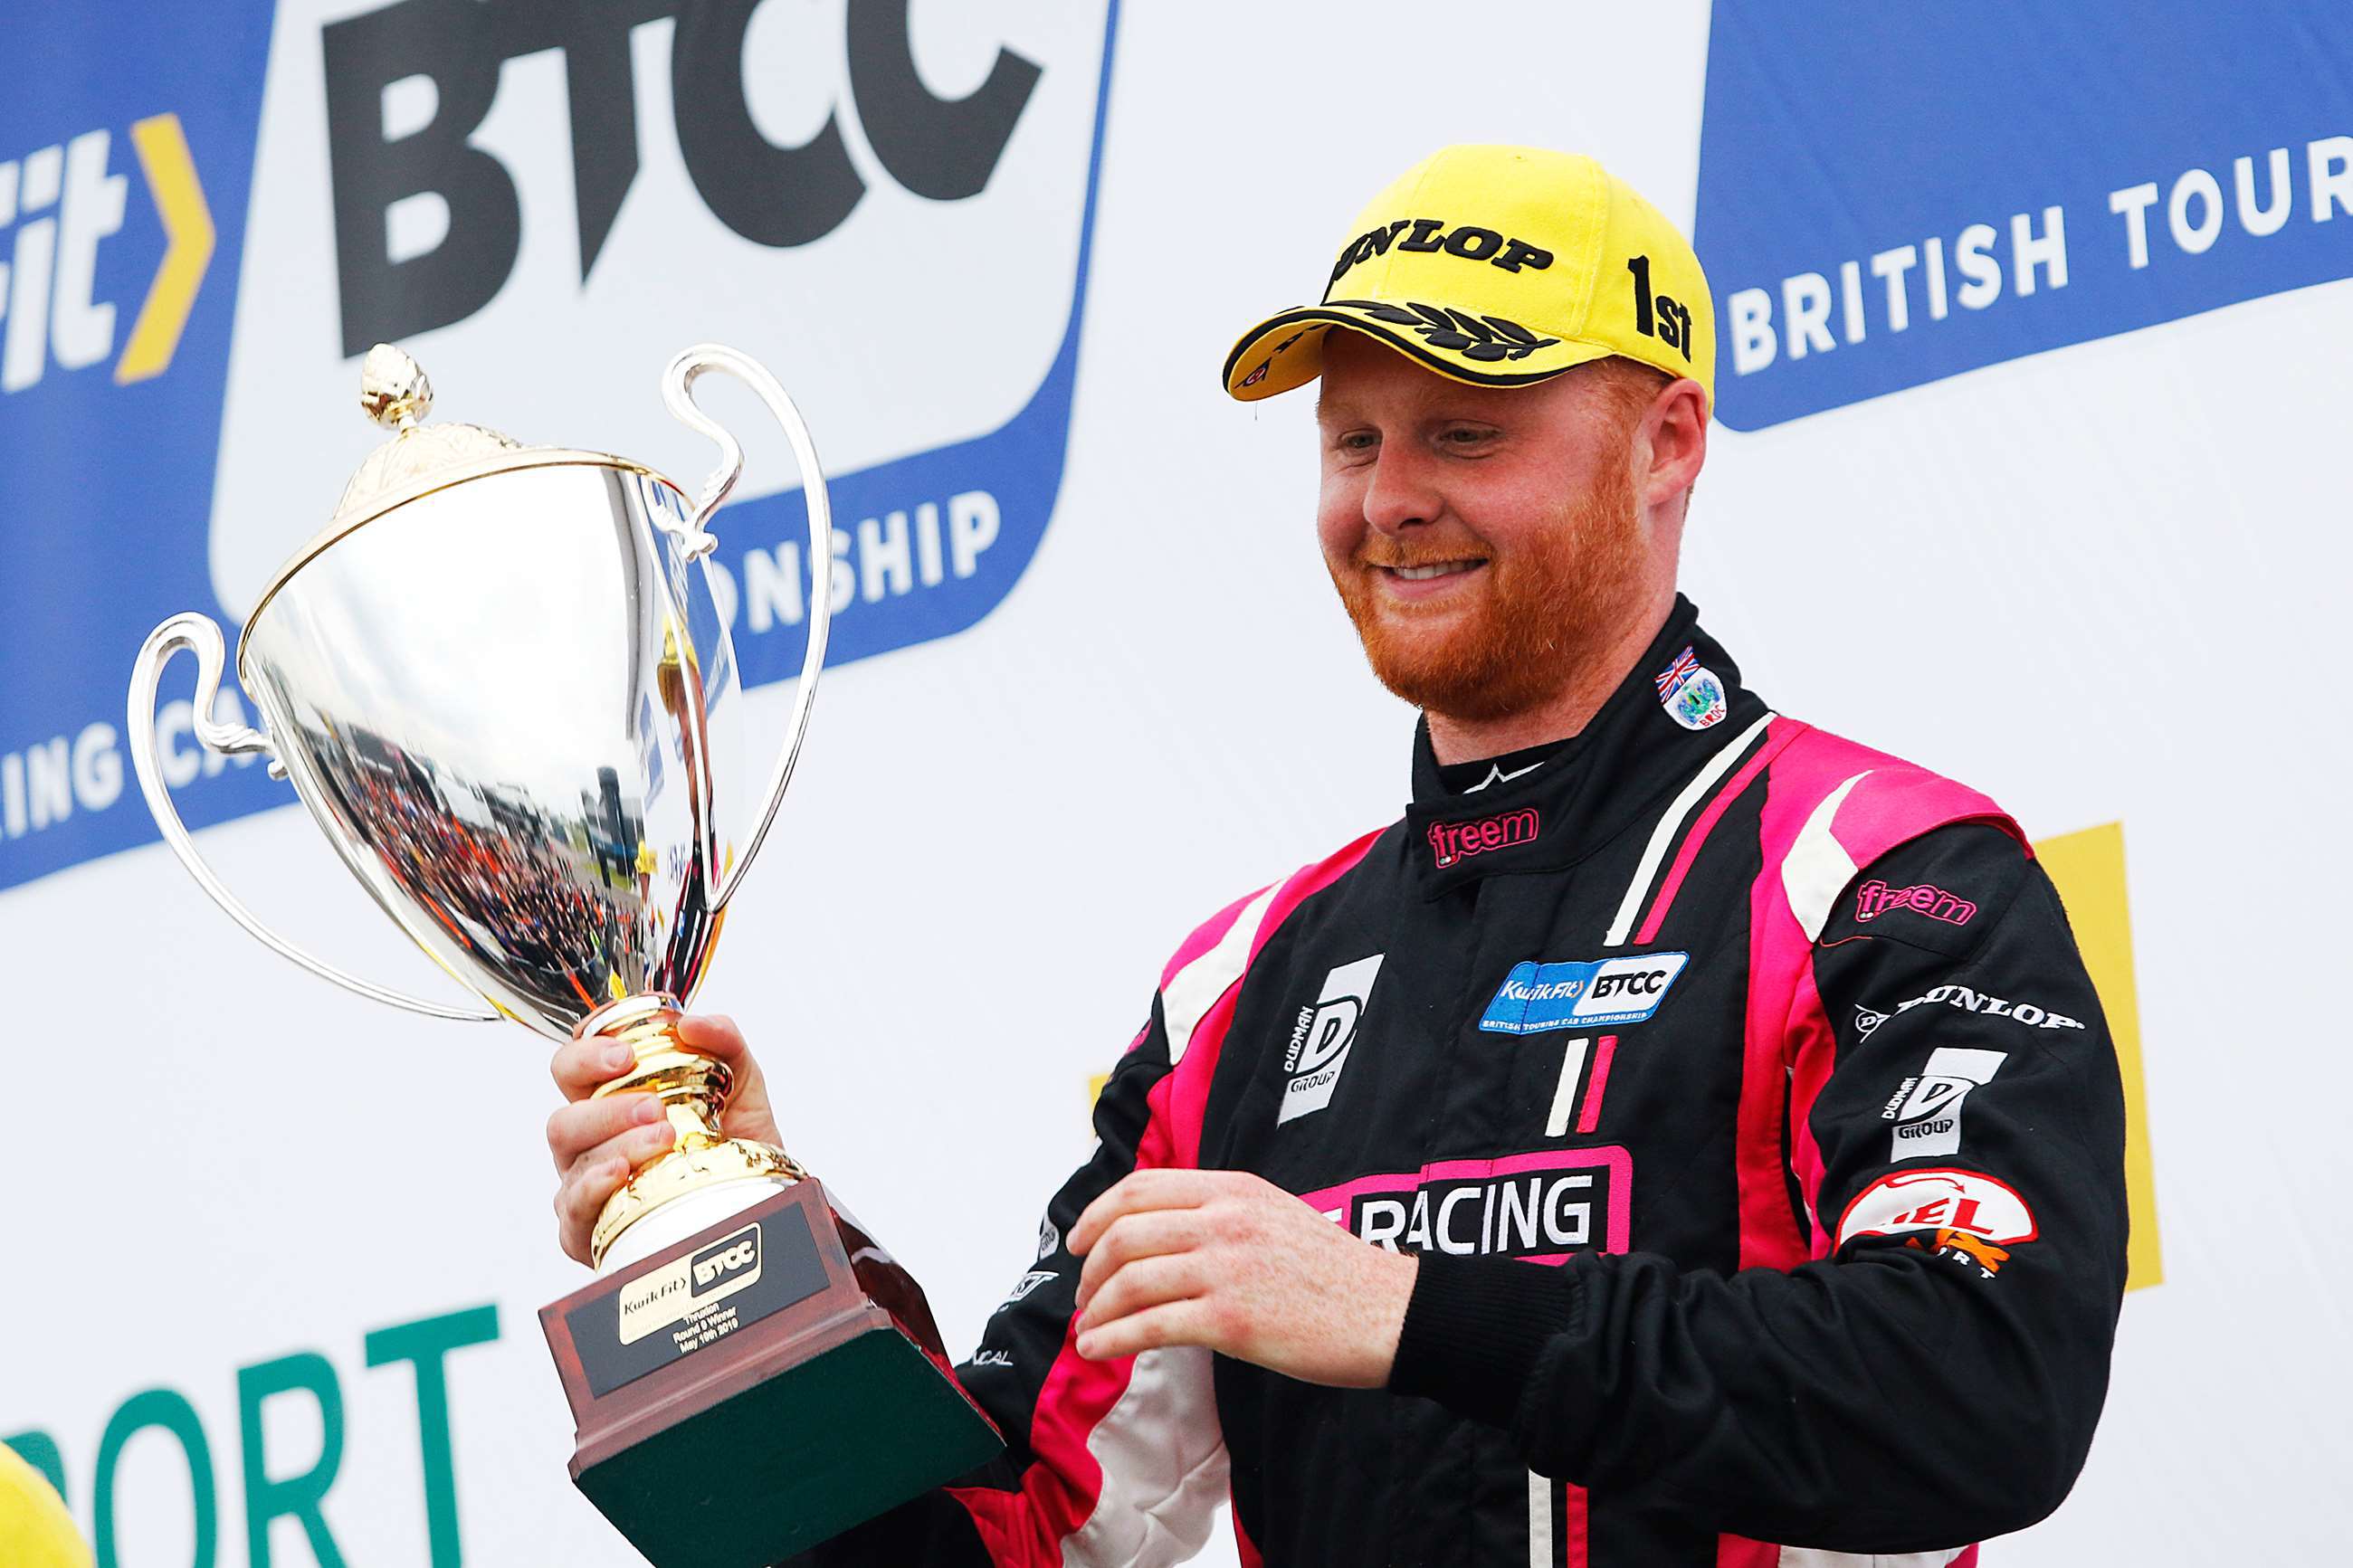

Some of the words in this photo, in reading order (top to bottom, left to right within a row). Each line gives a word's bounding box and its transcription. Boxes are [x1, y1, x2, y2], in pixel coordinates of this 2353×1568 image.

[321, 0, 1043, 359] BTCC
[1729, 204, 2069, 376] BRITISH
[2109, 135, 2353, 270] TOUR
[1627, 254, 1691, 364] 1st
[155, 685, 274, 789] CA
[1433, 812, 1535, 859] freem
[1862, 884, 1972, 921] freem
[1591, 970, 1667, 999] BTCC
[1891, 984, 2079, 1030] DUNLOP
[1283, 1005, 1315, 1073] DUDMAN
[1482, 1020, 1520, 1031] BRITISH
[1522, 1018, 1560, 1031] TOURING
[1561, 1016, 1578, 1025] CAR
[1581, 1012, 1648, 1024] CHAMPIONSHIP
[1291, 1071, 1336, 1093] GROUP
[1881, 1077, 1919, 1119] DUDMAN
[1899, 1119, 1954, 1139] GROUP
[1360, 1175, 1593, 1256] RACING
[692, 1240, 756, 1287] BTCC
[672, 1322, 700, 1344] Round
[707, 1307, 737, 1326] Winner
[680, 1338, 699, 1354] May
[718, 1317, 738, 1335] 2019
[0, 1303, 500, 1568] ORT
